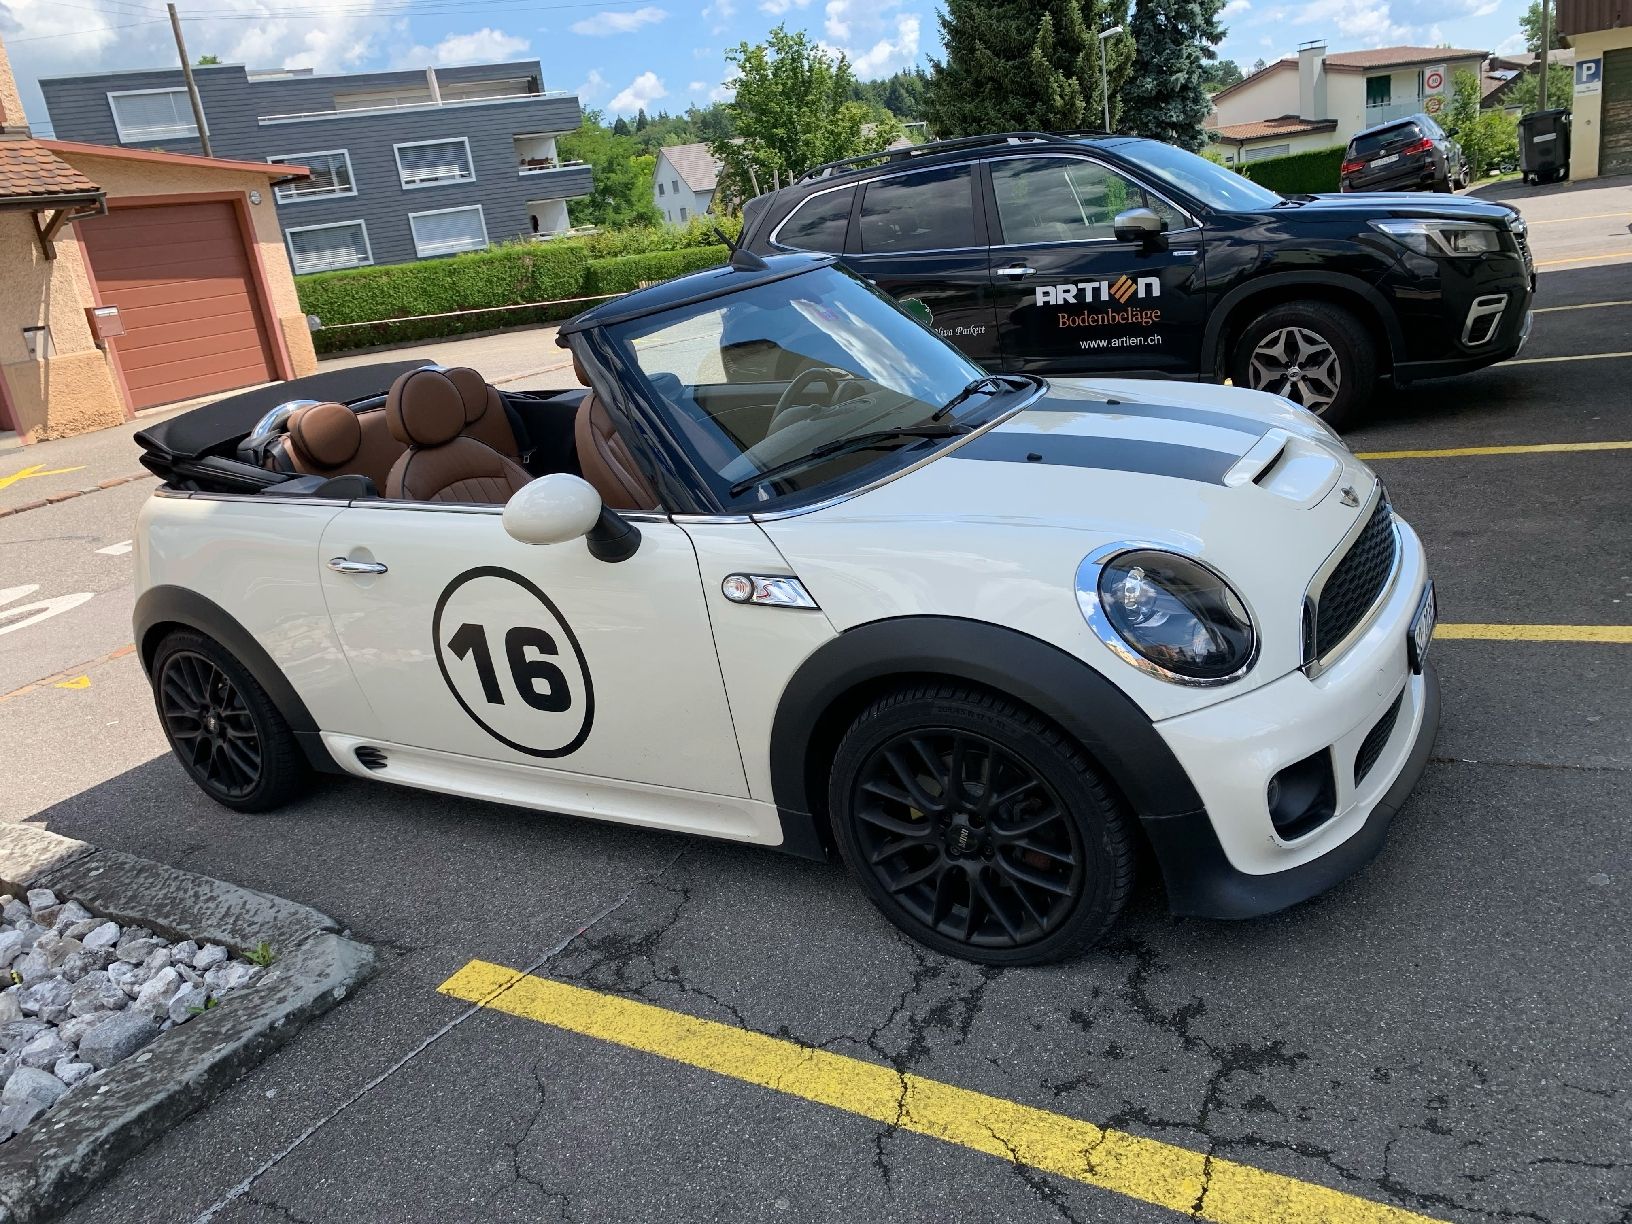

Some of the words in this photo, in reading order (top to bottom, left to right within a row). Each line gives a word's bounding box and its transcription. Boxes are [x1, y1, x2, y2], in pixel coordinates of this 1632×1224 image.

[1582, 62, 1596, 82] P
[1058, 307, 1161, 328] Bodenbeläge
[955, 325, 986, 337] Parkett
[1080, 334, 1162, 350] www.artien.ch
[446, 622, 572, 713] 16
